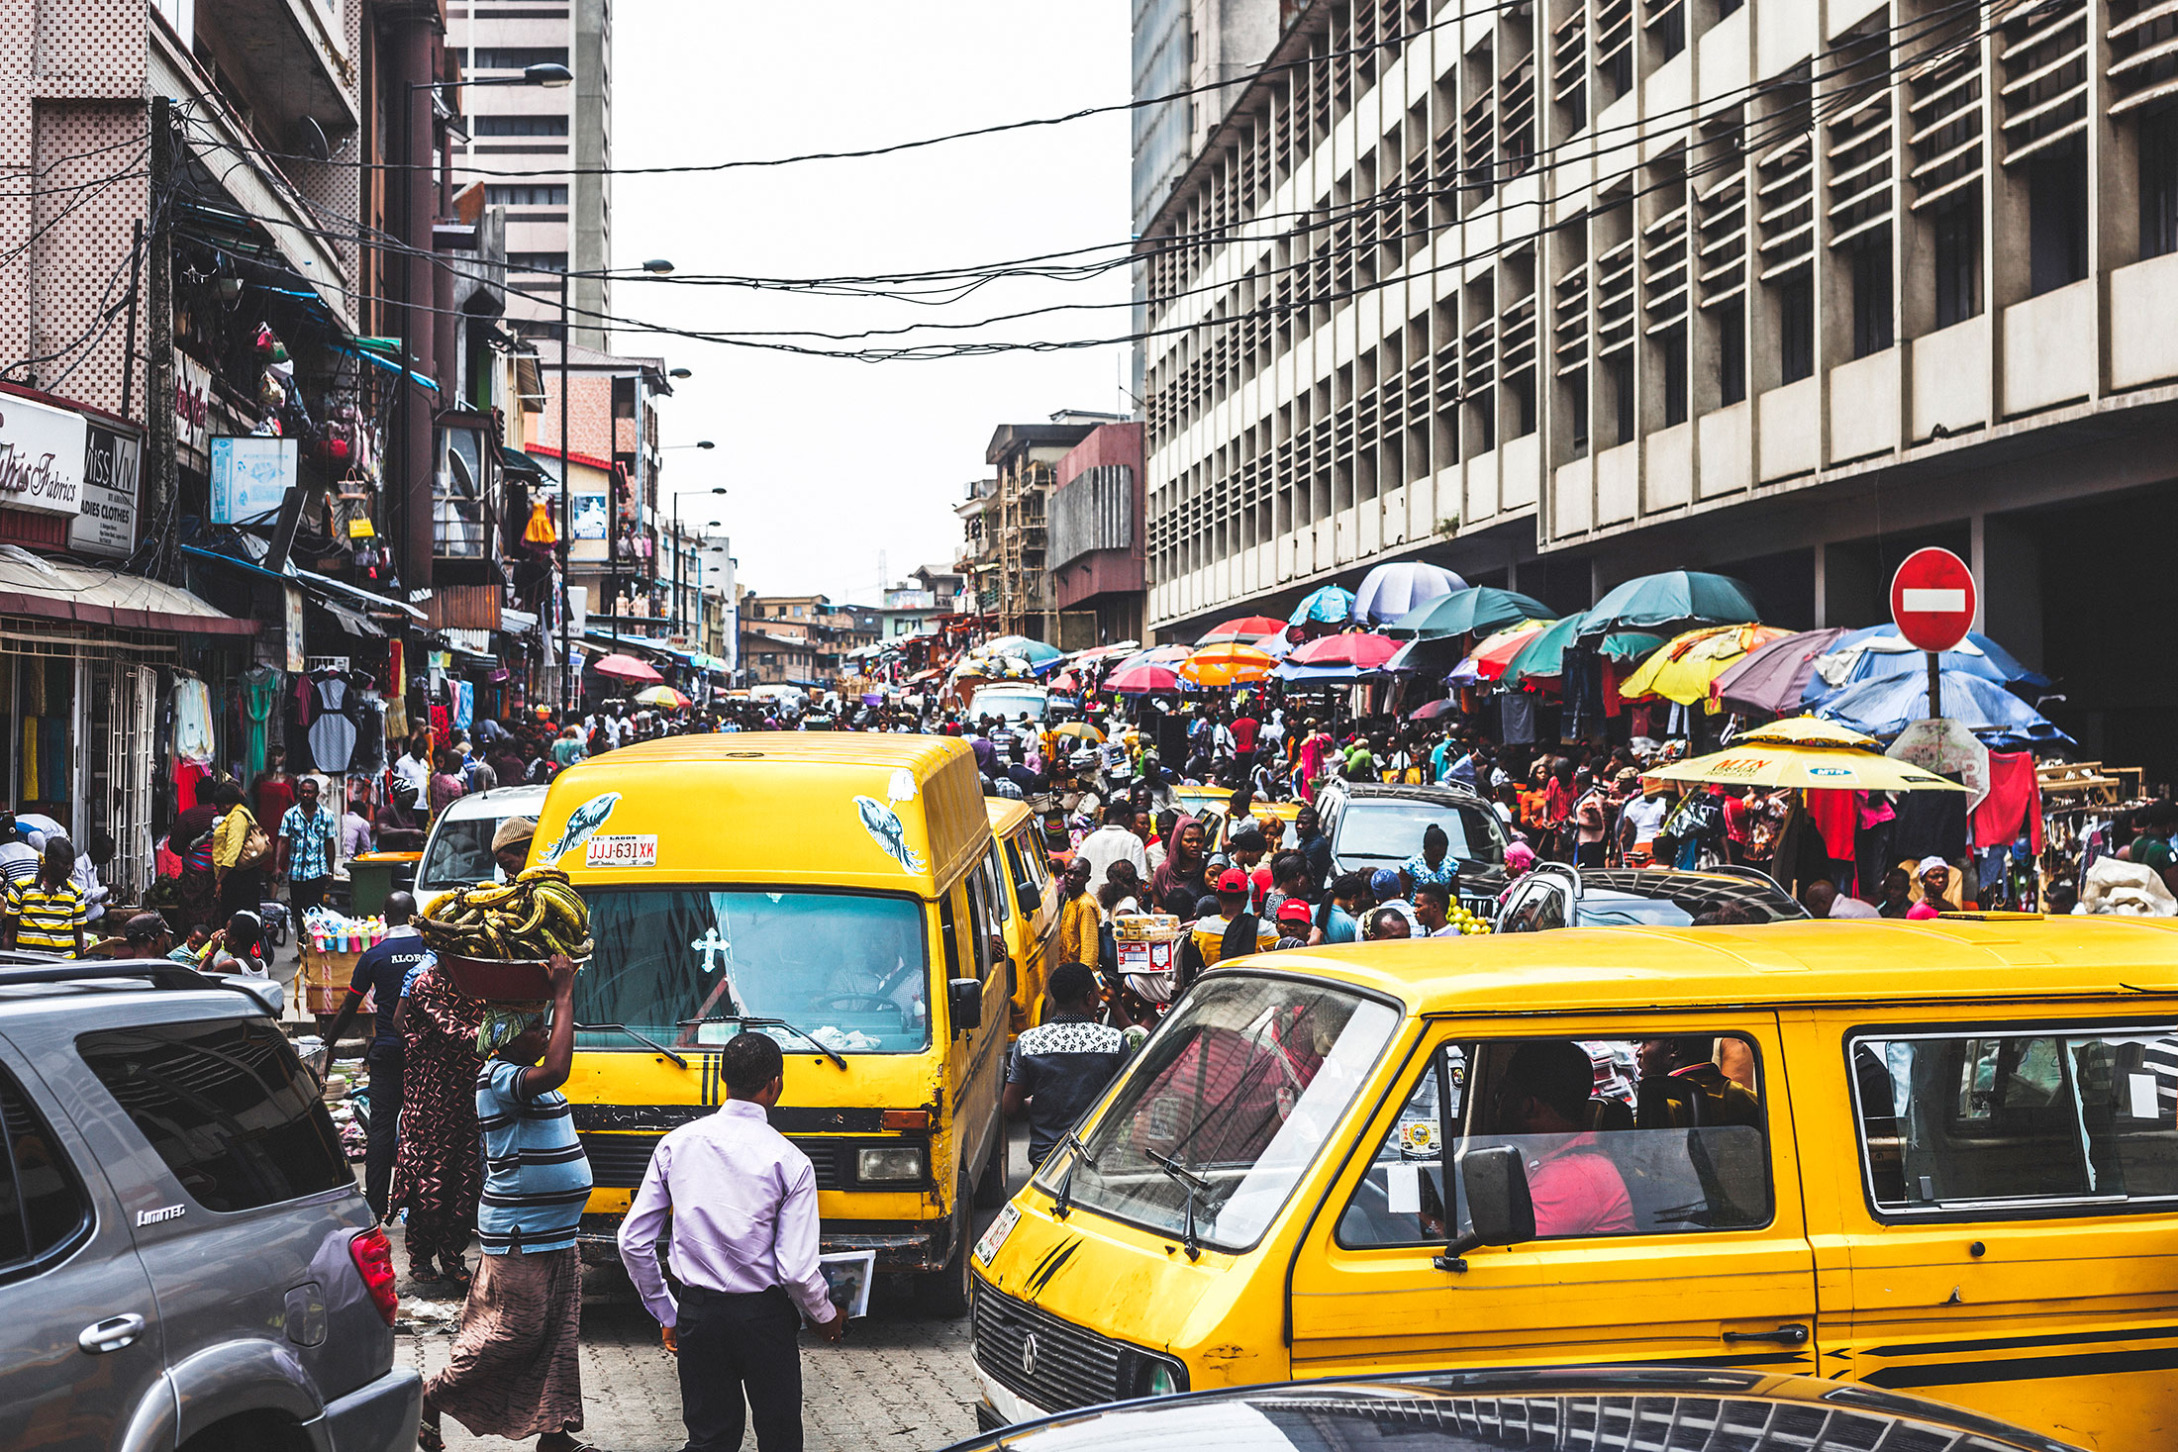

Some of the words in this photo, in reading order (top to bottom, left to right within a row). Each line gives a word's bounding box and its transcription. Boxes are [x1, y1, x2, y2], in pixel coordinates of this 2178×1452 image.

[31, 452, 77, 502] Fabrics
[80, 499, 100, 518] ADIES
[101, 504, 130, 525] CLOTHES
[1714, 759, 1773, 769] MTN
